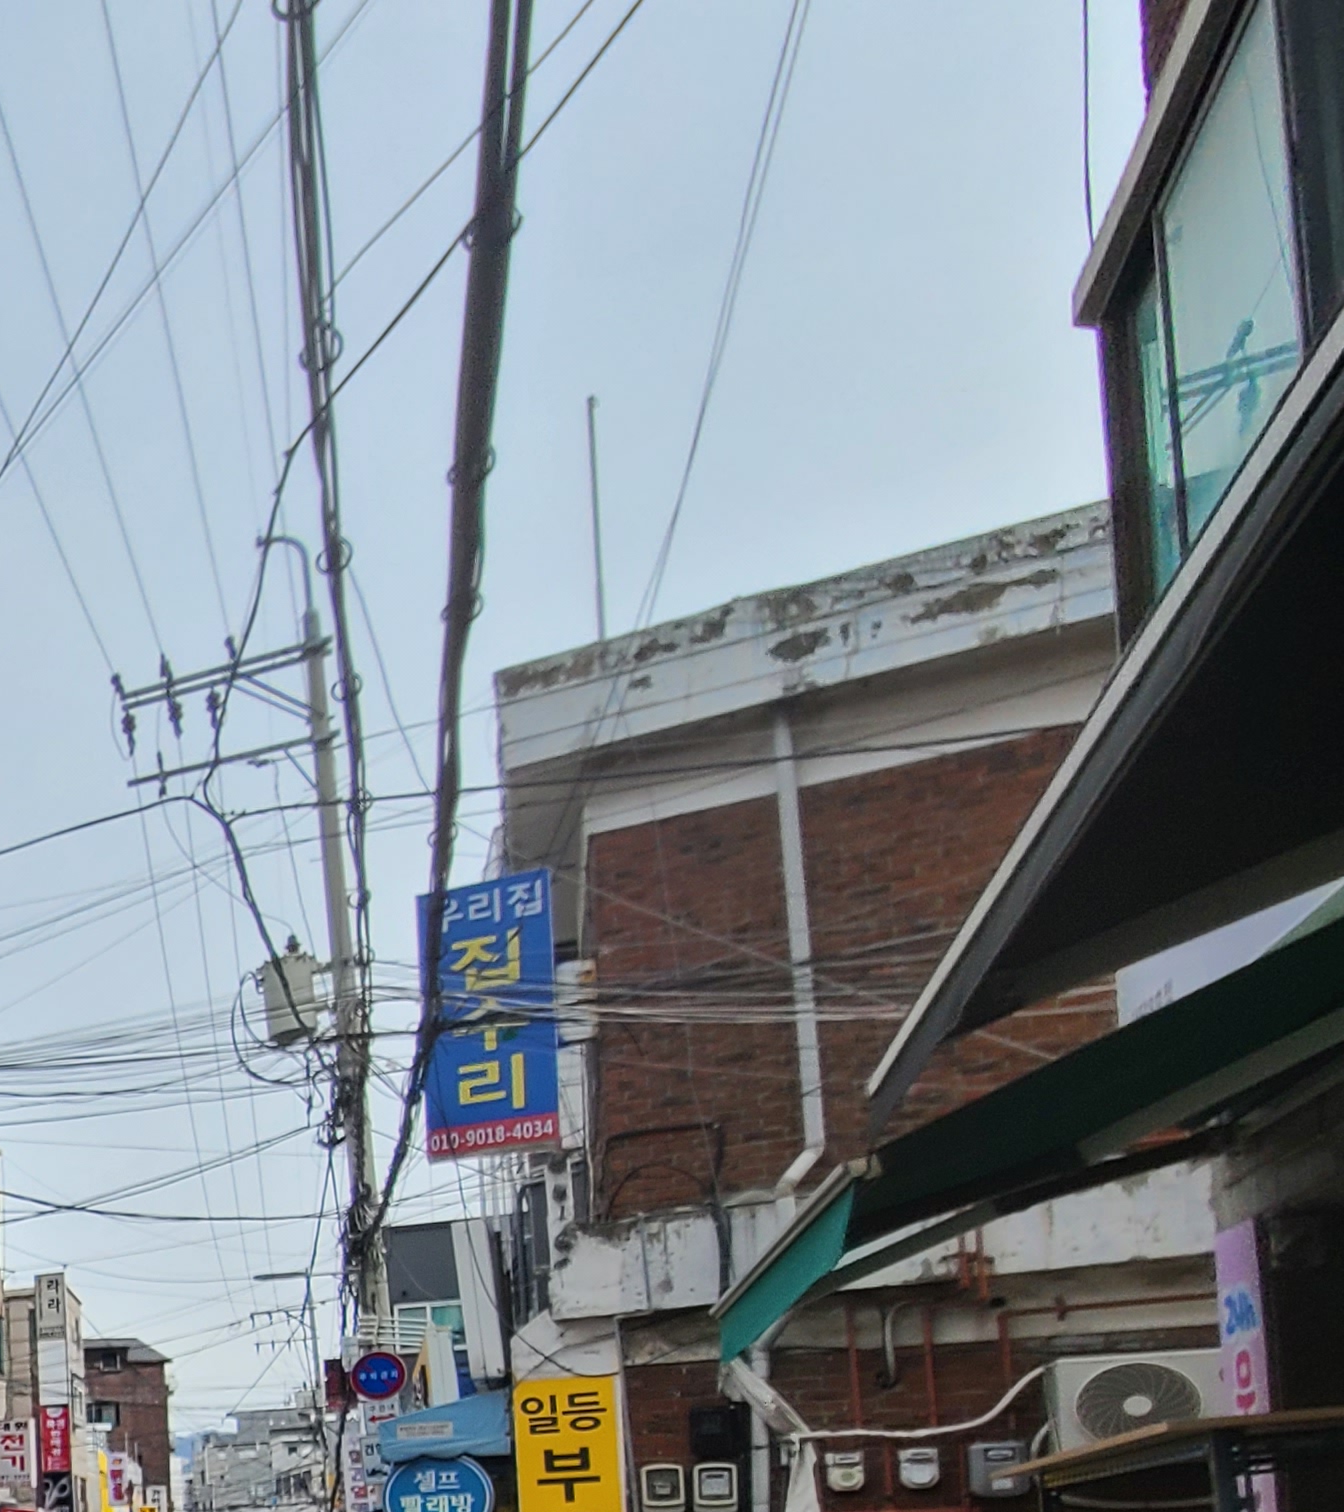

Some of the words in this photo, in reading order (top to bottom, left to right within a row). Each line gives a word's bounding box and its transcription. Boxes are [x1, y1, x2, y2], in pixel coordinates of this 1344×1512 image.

[441, 878, 543, 934] 우리집
[450, 927, 530, 1110] 집수리
[430, 1118, 554, 1152] 010-9018-4034
[520, 1391, 608, 1434] 일등
[0, 1434, 25, 1472] 전기
[414, 1469, 461, 1494] 셀프
